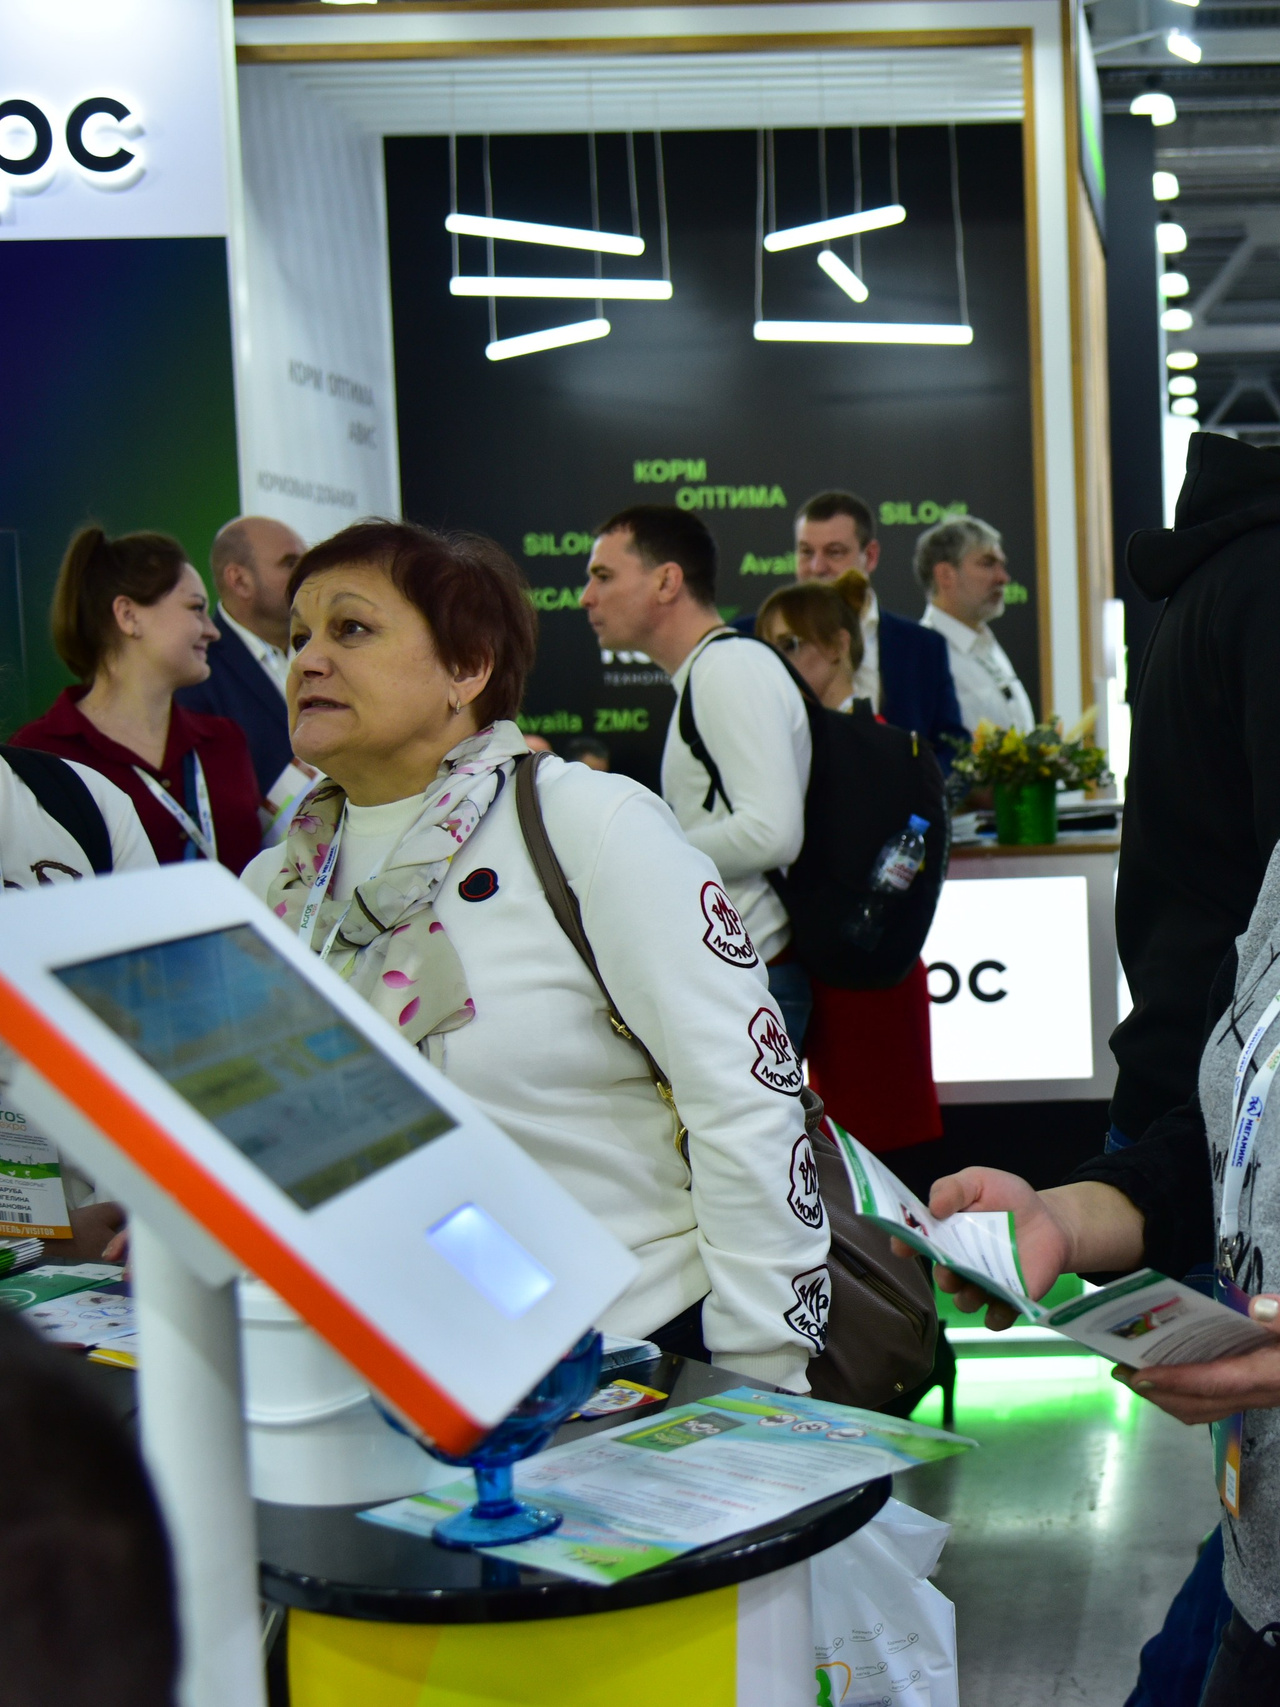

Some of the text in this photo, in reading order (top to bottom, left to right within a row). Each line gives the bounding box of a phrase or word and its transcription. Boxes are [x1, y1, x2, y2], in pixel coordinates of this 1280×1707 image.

[633, 458, 707, 483] КОРМ
[675, 484, 787, 510] ОПТИМА
[516, 708, 649, 733] Availa ZMC
[1236, 1118, 1254, 1168] МЕГАМИКС
